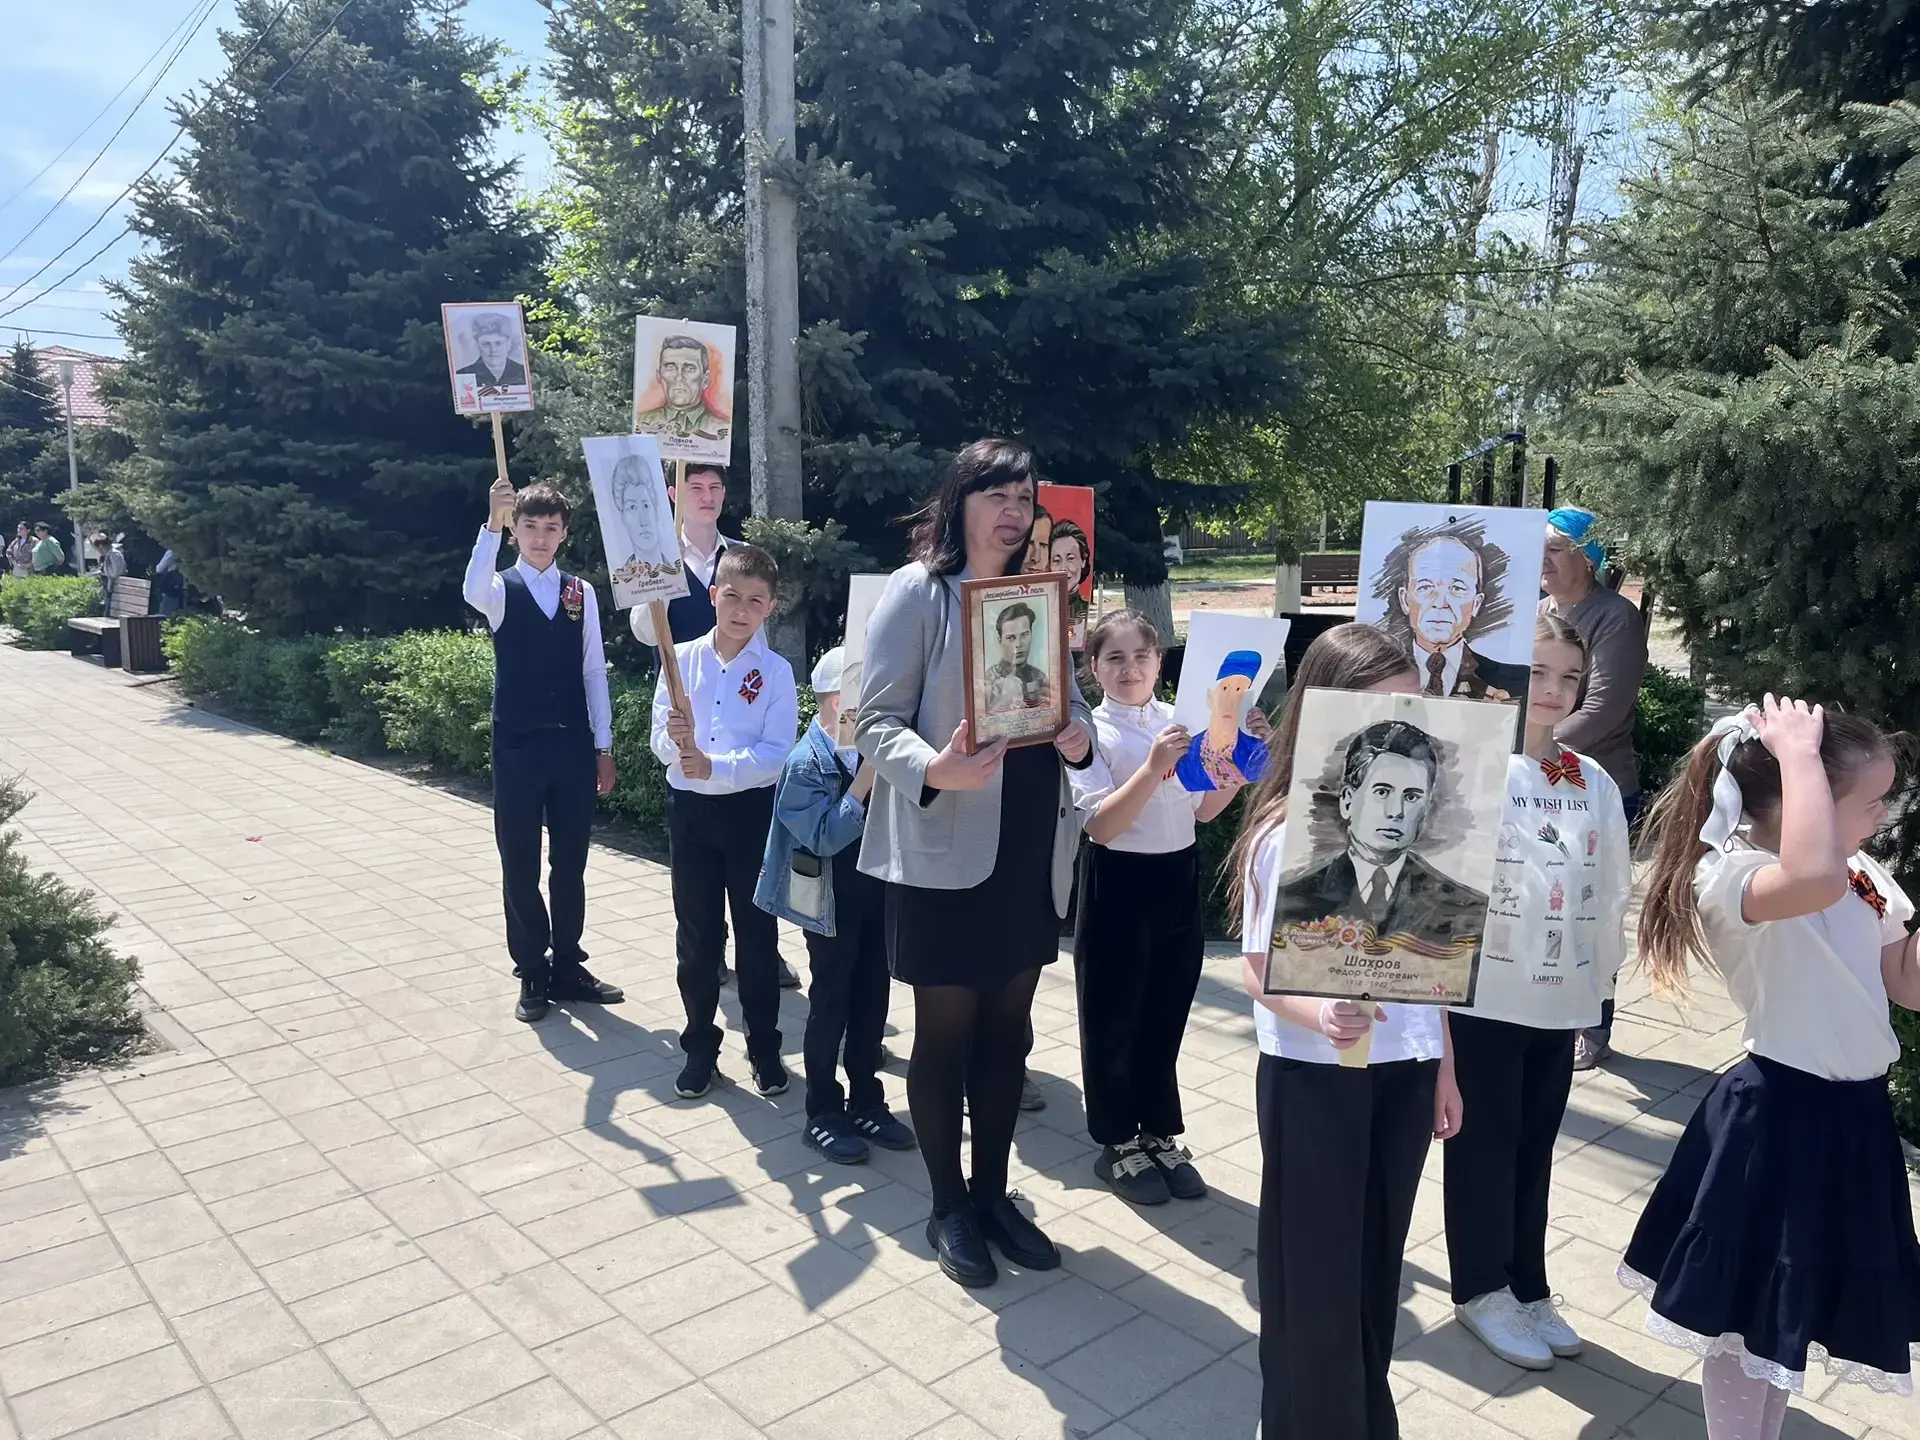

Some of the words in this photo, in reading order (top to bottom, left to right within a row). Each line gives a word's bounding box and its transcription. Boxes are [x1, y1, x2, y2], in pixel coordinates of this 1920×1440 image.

[1511, 796, 1528, 808] MY
[1533, 798, 1562, 810] WISH
[1567, 799, 1589, 811] LIST
[1344, 955, 1401, 969] Шахров
[1327, 966, 1362, 977] Федор
[1363, 968, 1420, 981] Сергеевич
